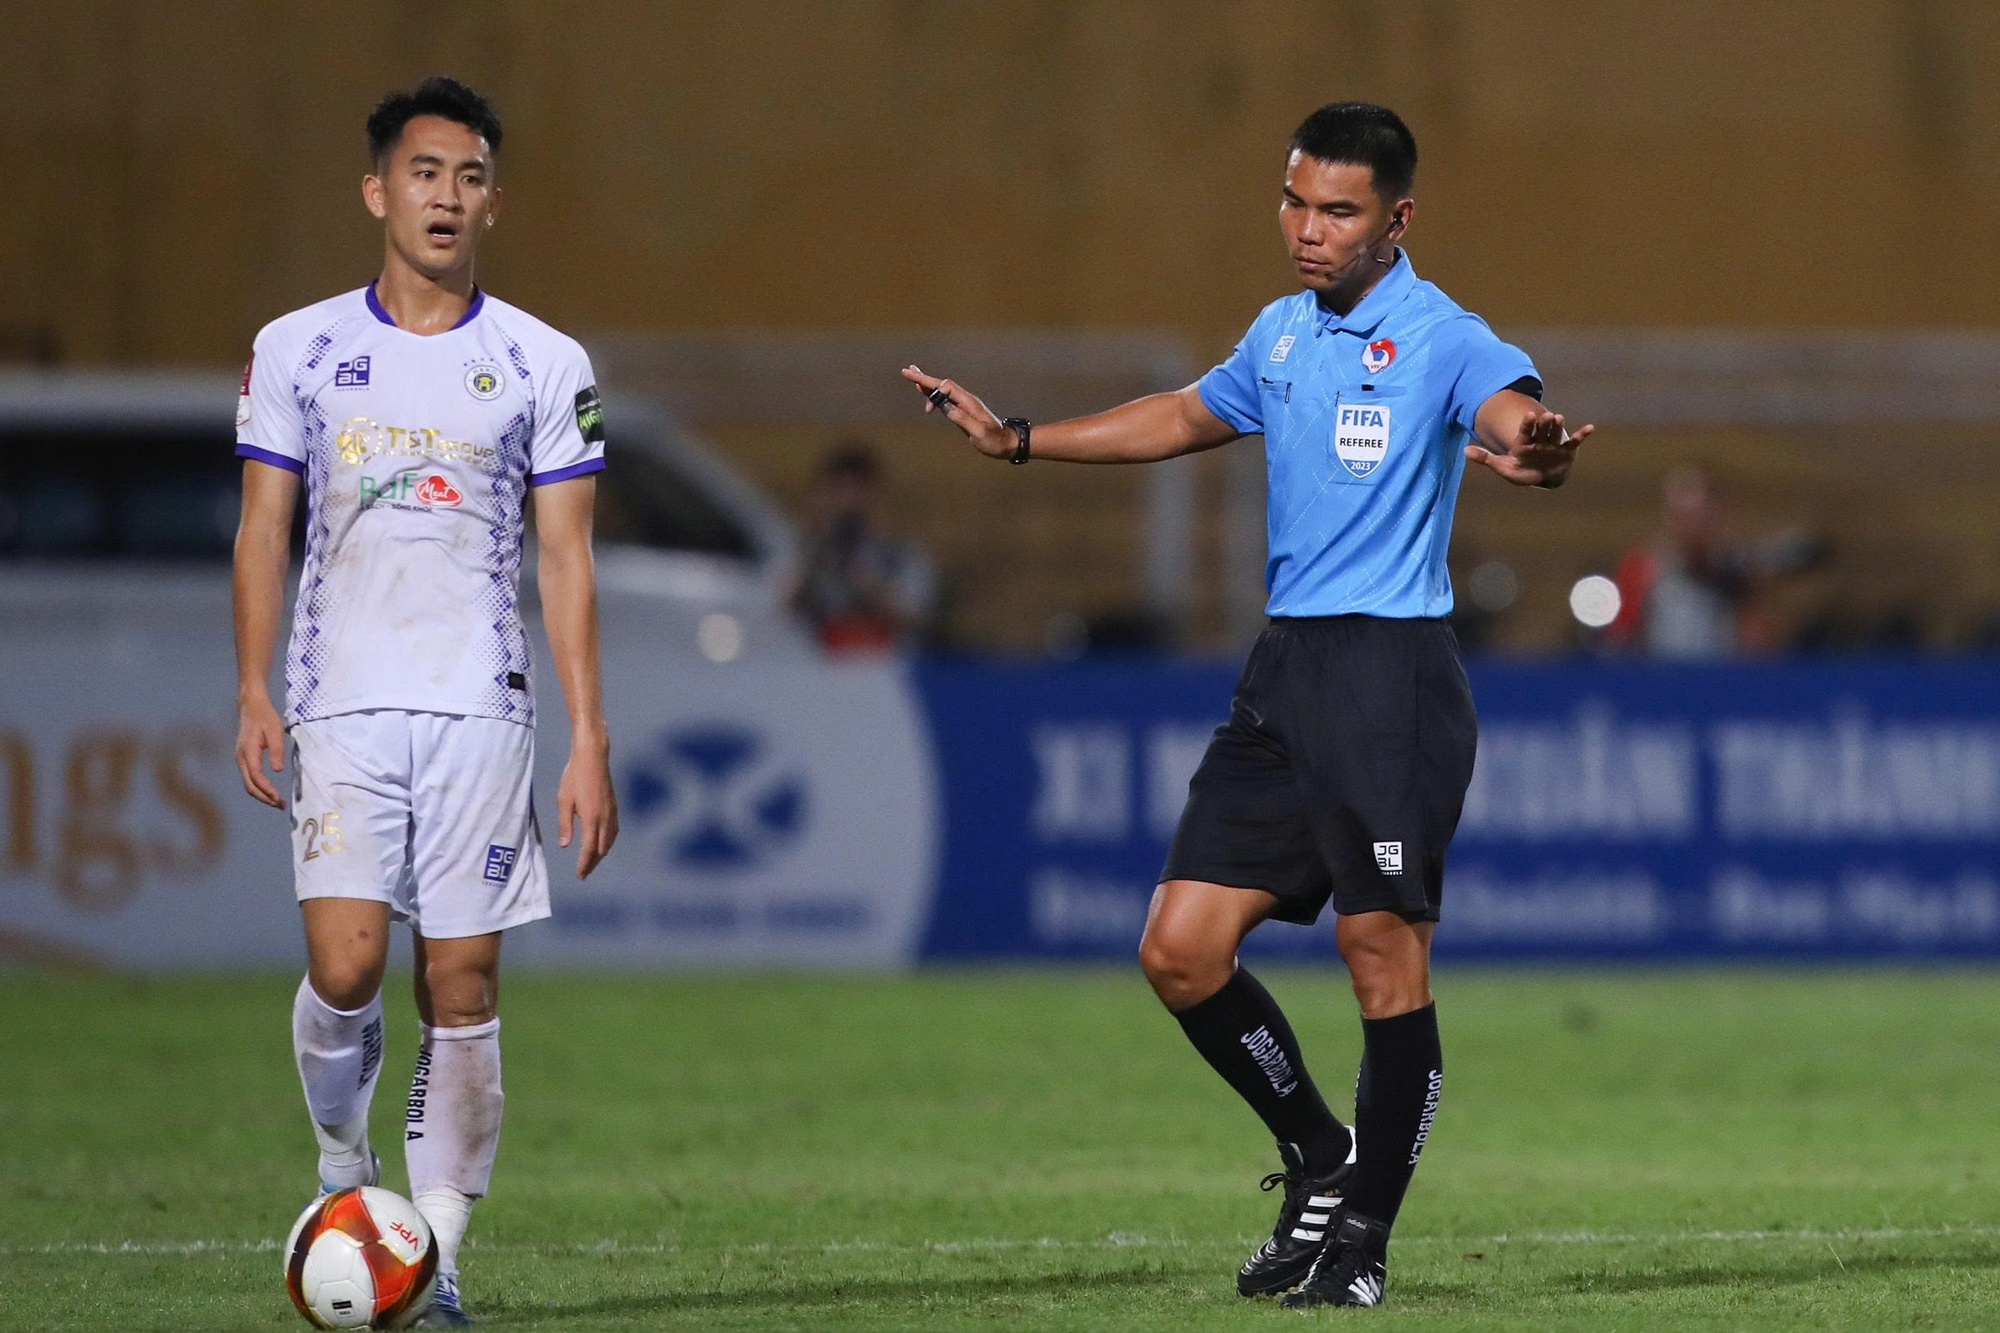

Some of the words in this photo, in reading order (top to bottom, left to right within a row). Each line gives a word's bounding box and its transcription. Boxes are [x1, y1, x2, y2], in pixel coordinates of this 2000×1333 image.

[1341, 410, 1384, 427] FIFA
[1339, 437, 1384, 449] REFEREE
[1350, 461, 1371, 471] 2023
[302, 811, 345, 863] 25
[1240, 1024, 1298, 1098] JOGARBOLA
[1408, 1069, 1443, 1165] JOGARBOLA
[389, 1221, 418, 1252] VPF
